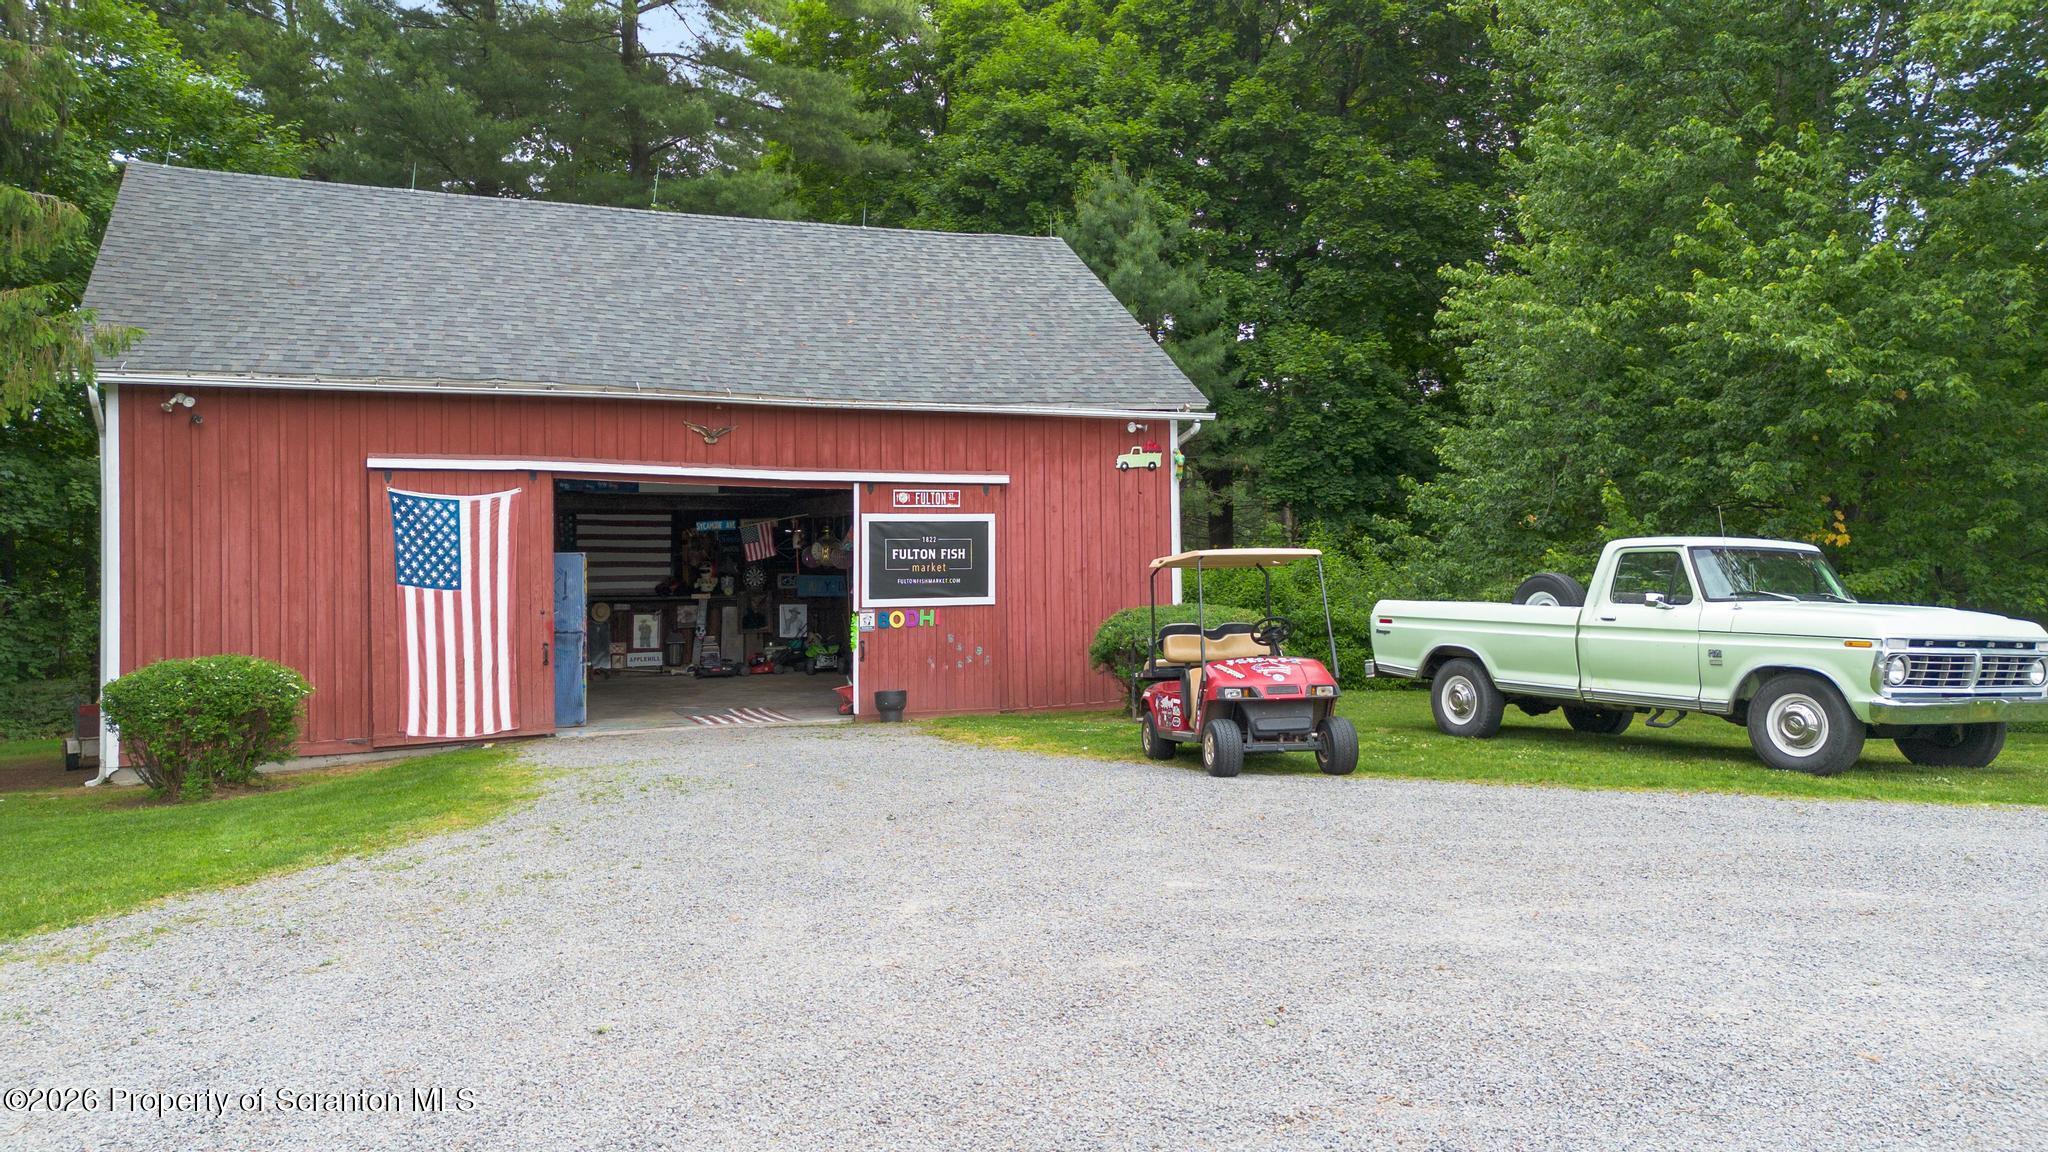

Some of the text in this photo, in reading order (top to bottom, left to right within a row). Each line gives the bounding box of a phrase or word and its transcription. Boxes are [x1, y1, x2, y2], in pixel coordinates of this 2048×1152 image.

[915, 492, 947, 505] FULTON
[892, 548, 966, 560] FULTON FISH
[911, 562, 947, 572] market
[878, 608, 941, 629] BODHI
[1924, 640, 2024, 649] FORD
